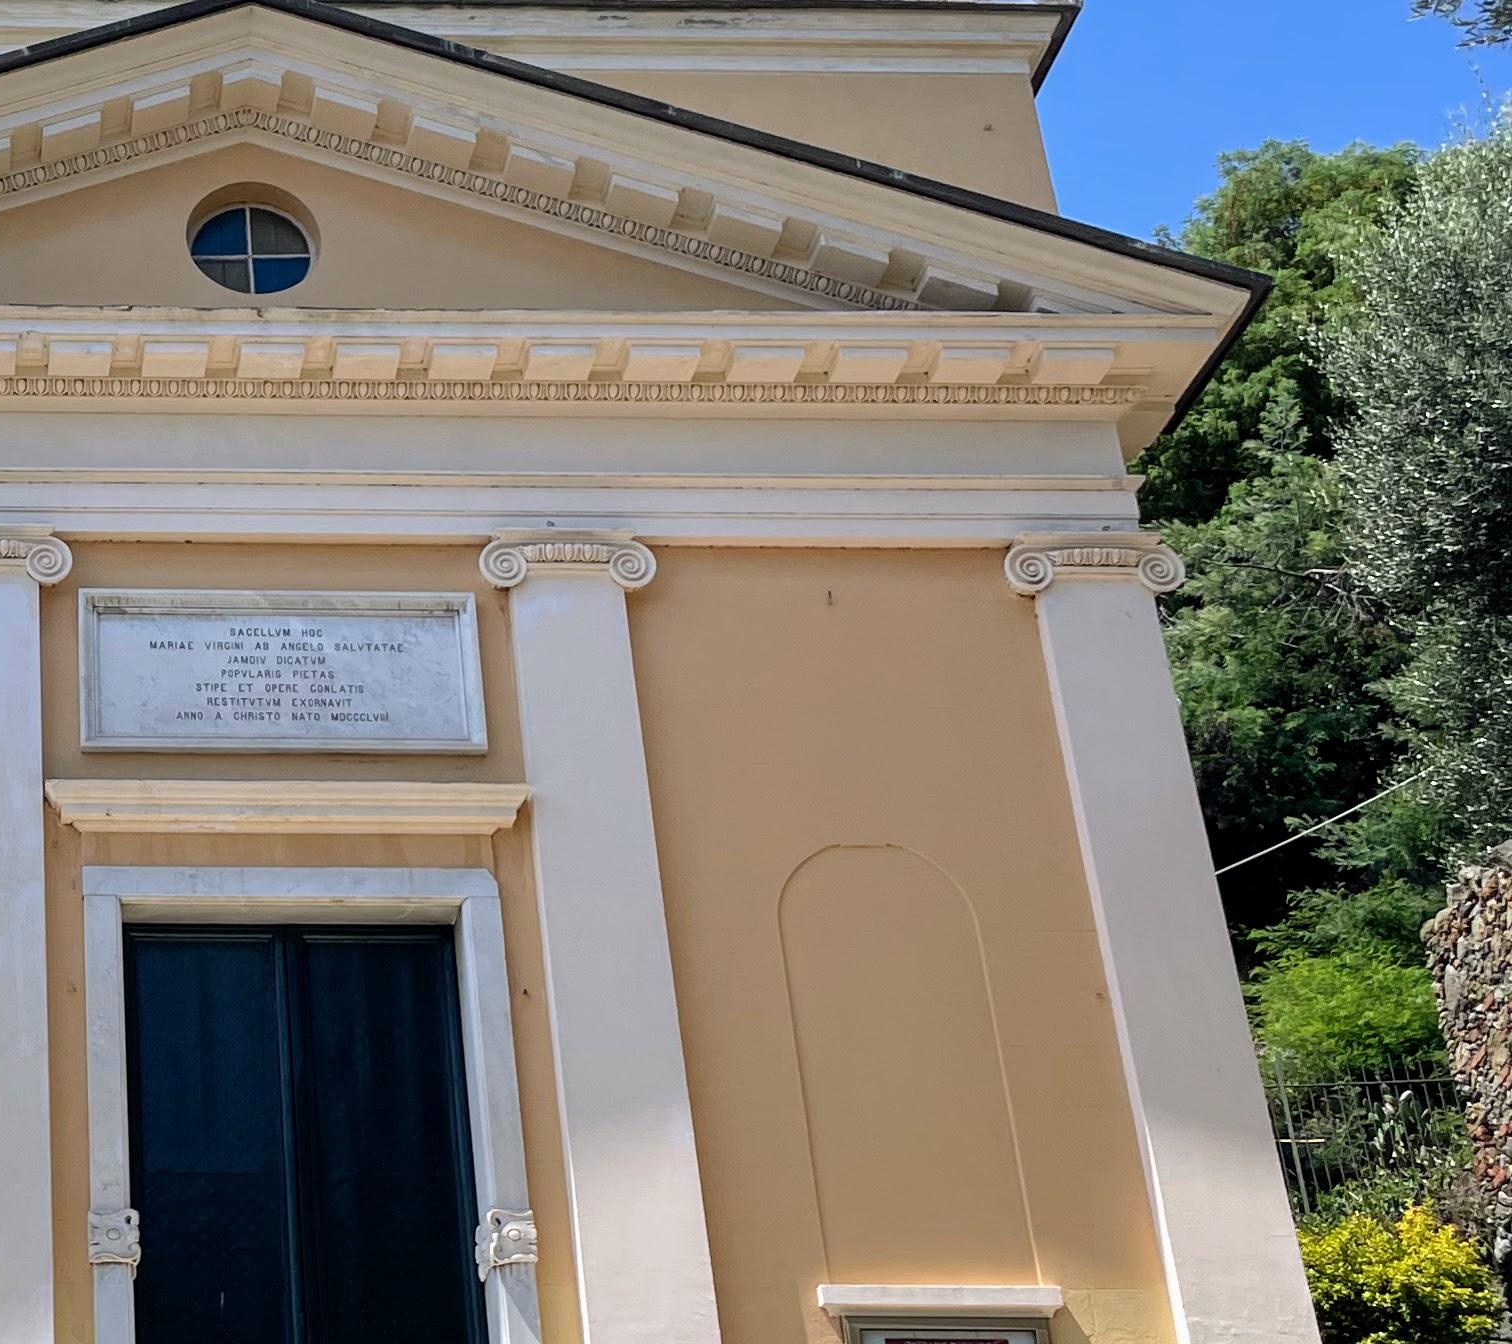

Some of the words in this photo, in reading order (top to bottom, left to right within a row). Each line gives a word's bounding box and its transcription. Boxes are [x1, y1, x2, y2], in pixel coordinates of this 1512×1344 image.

[229, 627, 291, 637] SACELLVM
[301, 628, 323, 638] HOC
[149, 640, 194, 650] MARIAE
[204, 641, 244, 651] VIRGINI
[254, 641, 269, 651] AB
[280, 642, 324, 652] ANGELO
[334, 642, 405, 653] SALVTATAE
[276, 655, 326, 665] DICATVM
[220, 669, 282, 679] POPVLARIS
[292, 669, 335, 679] PIETAS
[195, 682, 228, 693] STIPE
[238, 683, 254, 693] ET
[264, 683, 299, 693] OPERE
[310, 684, 365, 694] CONLATIS
[206, 697, 281, 707] RESTITVTVM
[291, 698, 352, 708] EXORNAVIT
[176, 711, 204, 721] ANNO
[214, 711, 223, 721] A
[233, 711, 281, 721] CHRISTO
[291, 712, 321, 722] NATO
